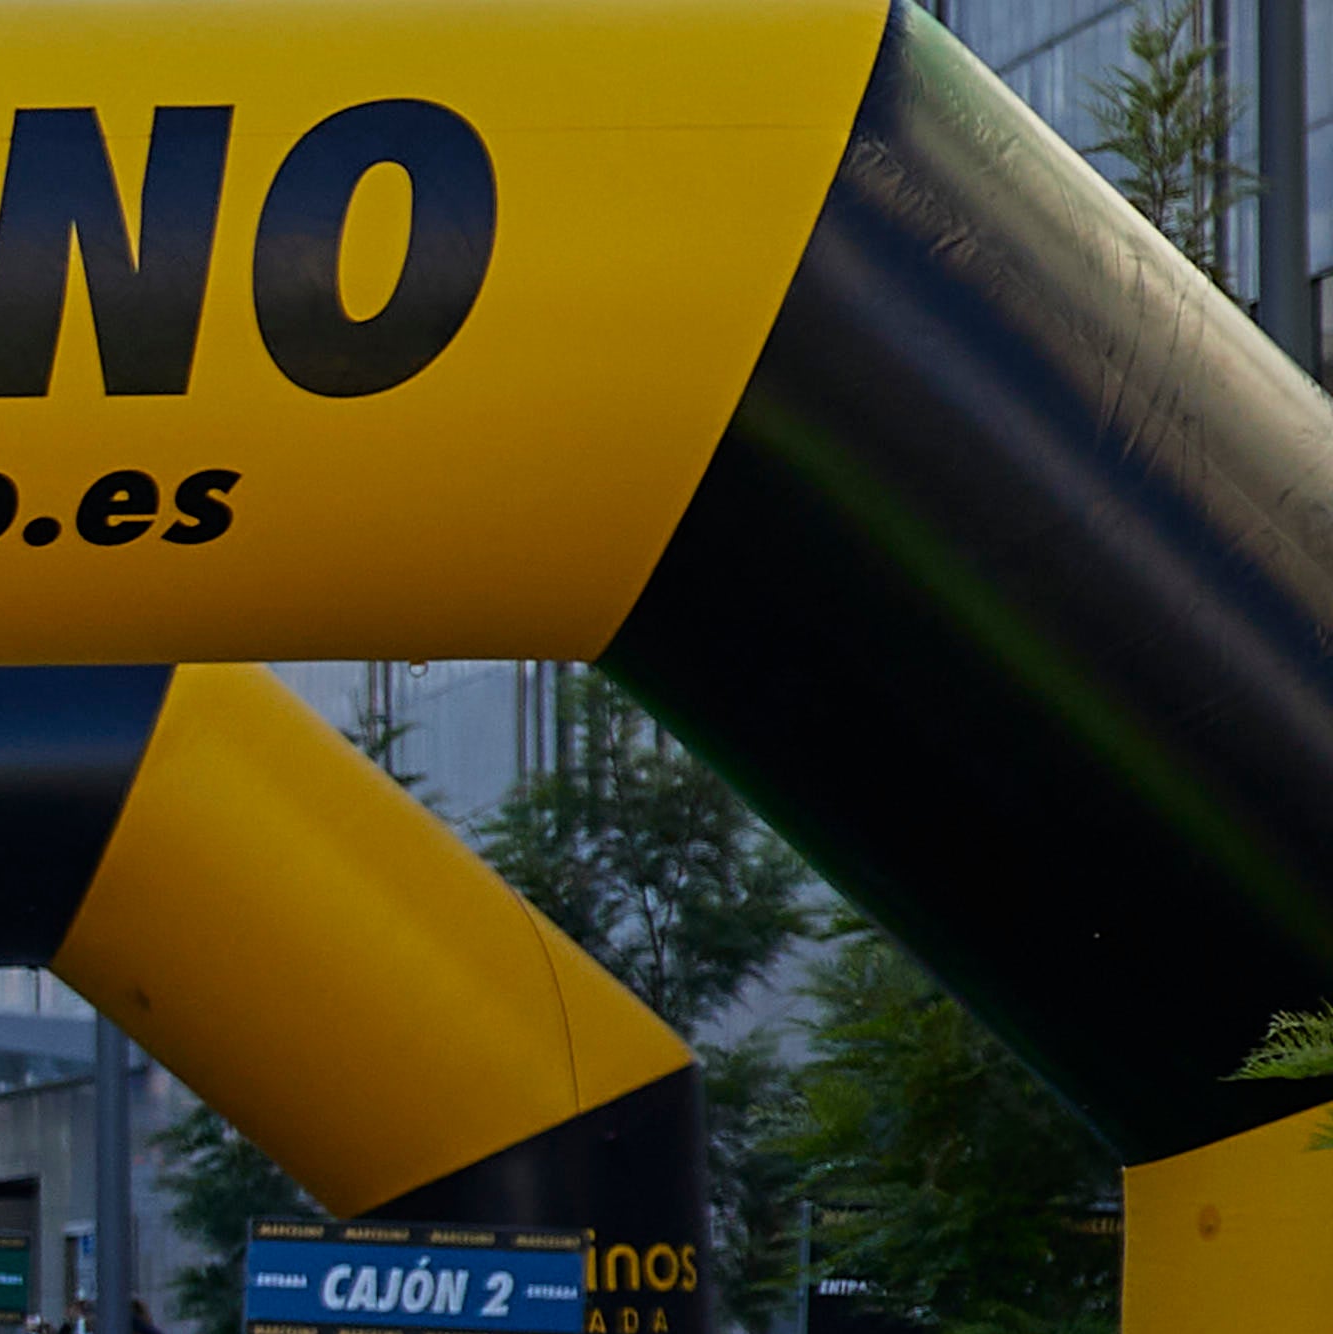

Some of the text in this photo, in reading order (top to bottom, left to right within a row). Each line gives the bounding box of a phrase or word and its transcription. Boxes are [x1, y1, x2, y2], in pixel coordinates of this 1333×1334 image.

[253, 1271, 308, 1288] ENTRADA
[321, 1255, 514, 1317] CAJÓN 2
[526, 1284, 579, 1299] ENTRADA
